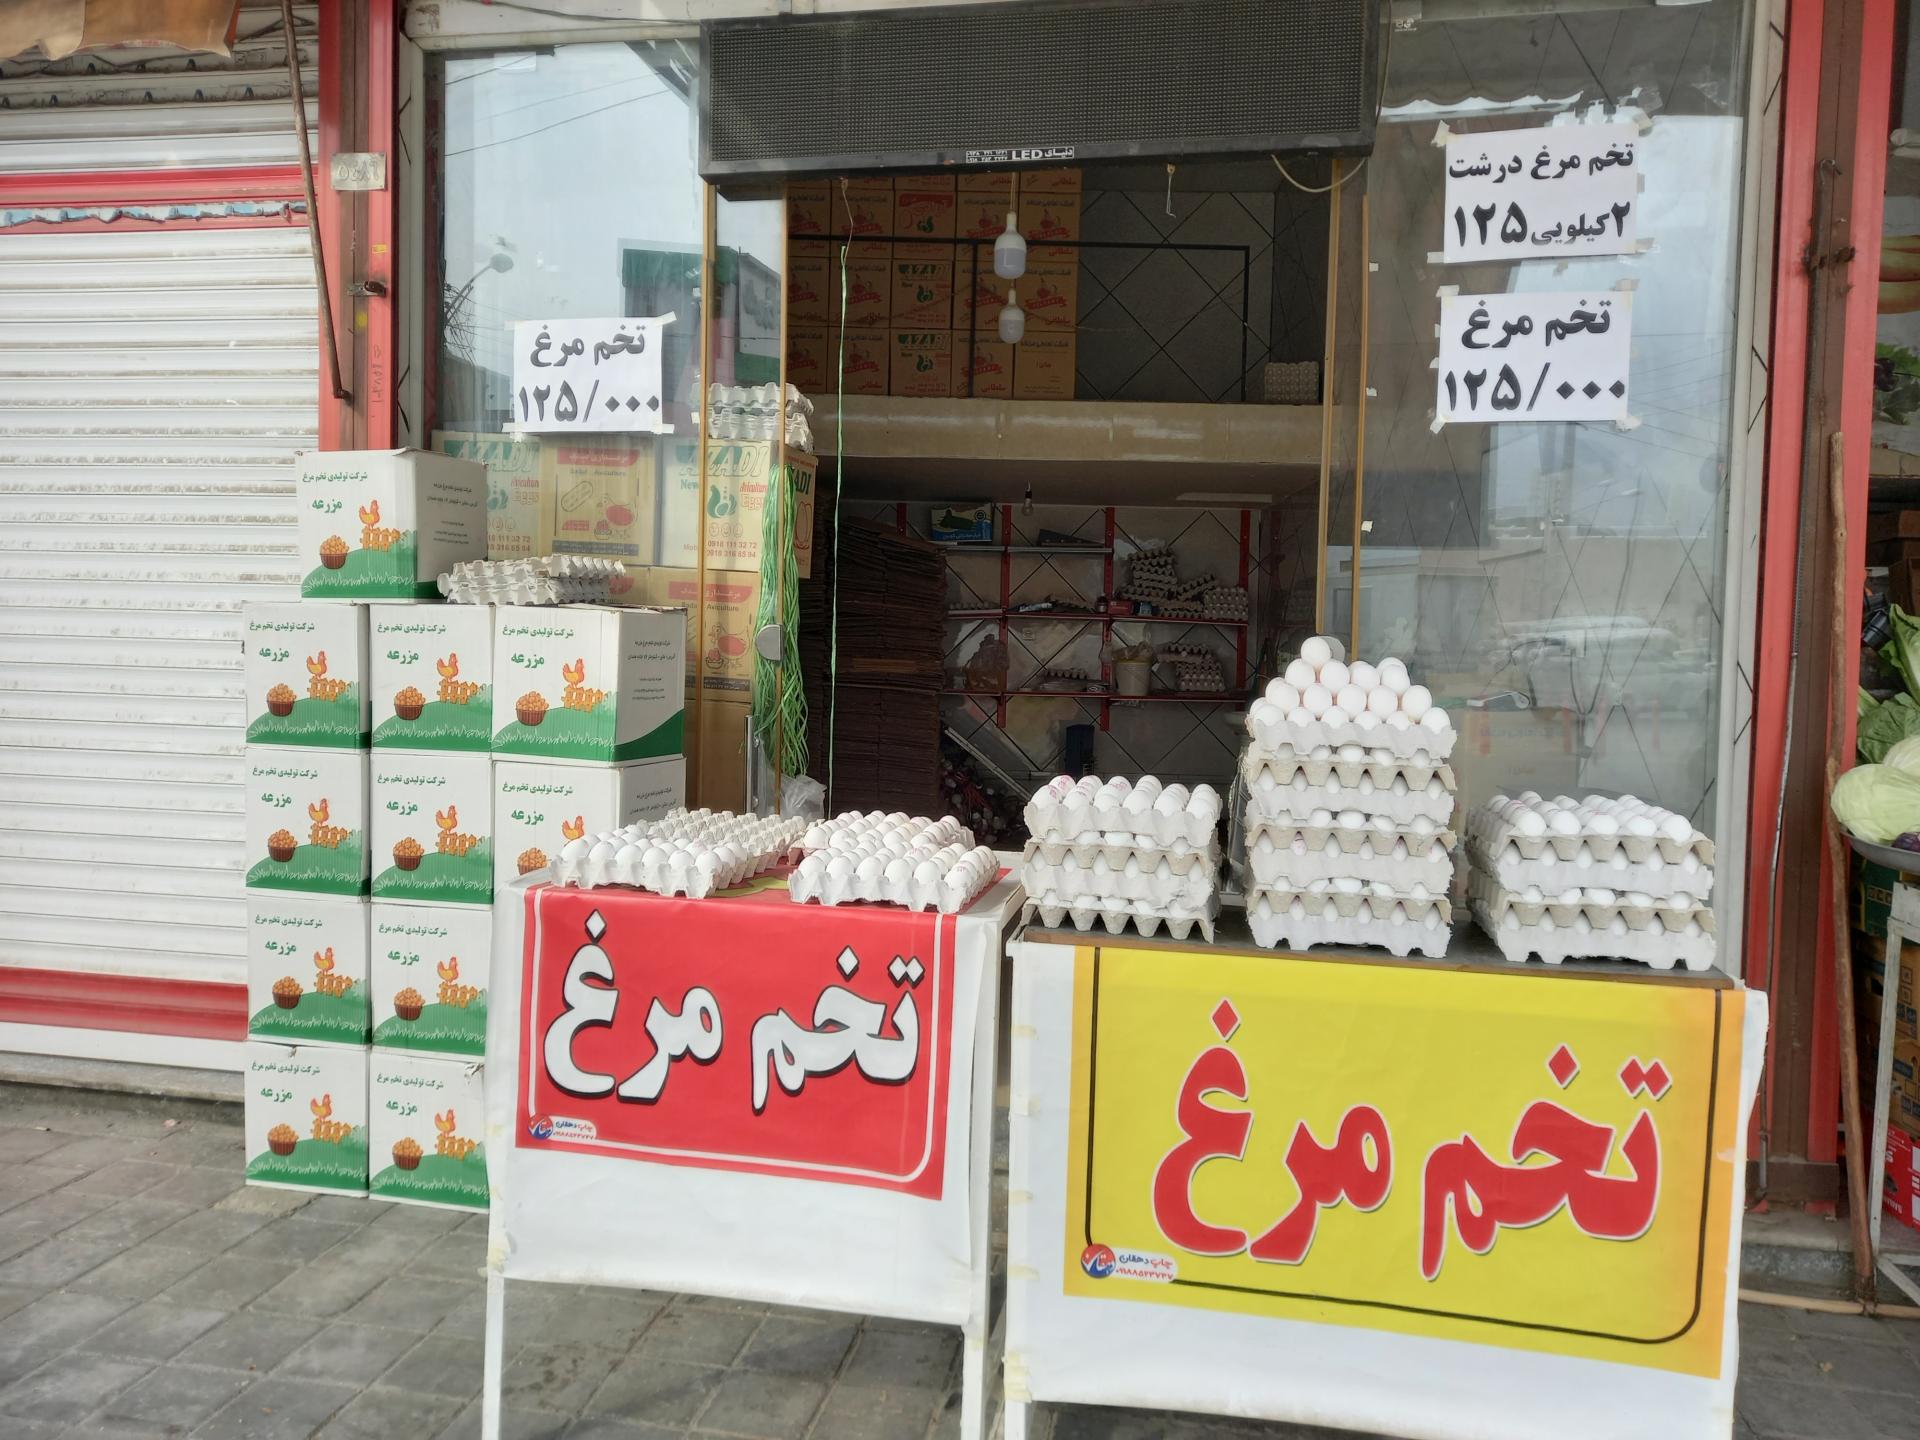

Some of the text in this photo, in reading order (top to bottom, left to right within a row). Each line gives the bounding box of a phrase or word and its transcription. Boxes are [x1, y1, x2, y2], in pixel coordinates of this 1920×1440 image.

[1011, 149, 1043, 160] LED
[1448, 142, 1635, 184] تخم مرغ درشت
[1461, 298, 1612, 349] تخم مرغ
[529, 323, 647, 368] تخم مرغ
[1445, 362, 1626, 412] ۱۲۵/۰۰۰
[518, 379, 660, 424] ۱۲۵/۰۰۰
[303, 471, 367, 483] شرکت تولیدی تخم مرغ
[311, 498, 343, 514] مزرعه
[250, 620, 314, 633] شرکت تولیدی تخم مرغ
[378, 623, 446, 635] شرکت تولیدی تخم مرغ
[503, 624, 574, 640] شرکت تولیدی تخم مرغ
[258, 647, 290, 663] مزرعه
[386, 649, 420, 665] مزرعه
[510, 652, 545, 669] مزرعه
[253, 766, 318, 780] شرکت تولیدی تخم مرغ
[377, 773, 445, 787] شرکت تولیدی تخم مرغ
[503, 781, 573, 797] شرکت تولیدی تخم مرغ
[260, 792, 292, 808] مزرعه
[386, 800, 419, 816] مزرعه
[510, 809, 545, 826] مزرعه
[255, 914, 322, 929] شرکت تولیدی تخم مرغ
[379, 922, 447, 938] شرکت تولیدی تخم مرغ
[264, 940, 297, 956] مزرعه
[387, 950, 420, 967] مزرعه
[542, 908, 926, 1116] تخم مرغ
[252, 1061, 320, 1076] شرکت تولیدی تخم مرغ
[377, 1073, 443, 1091] شرکت تولیدی تخم مرغ
[260, 1087, 293, 1103] مزرعه
[385, 1100, 418, 1117] مزرعه
[1151, 997, 1674, 1283] تخم مرغ
[1118, 1254, 1174, 1269] چاپ دهقان
